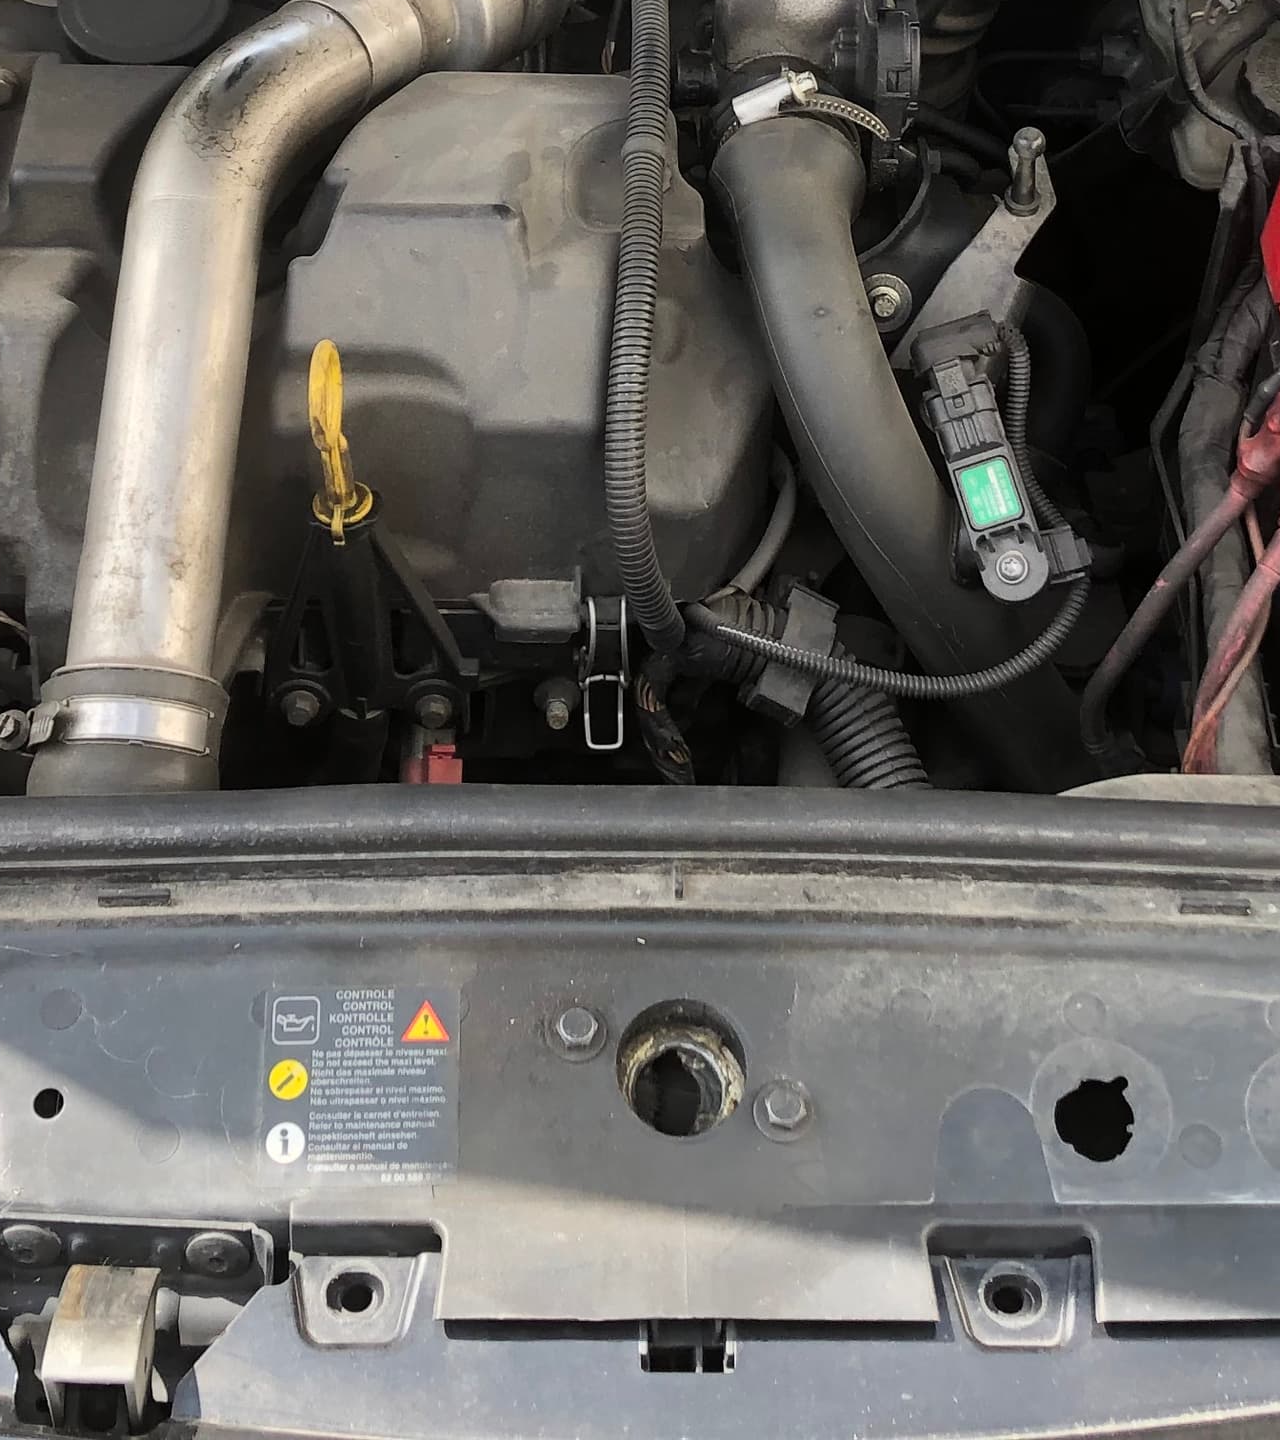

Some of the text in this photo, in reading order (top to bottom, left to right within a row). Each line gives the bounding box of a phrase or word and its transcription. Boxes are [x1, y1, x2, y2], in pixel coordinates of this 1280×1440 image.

[335, 989, 395, 1000] CONTROLE
[342, 1001, 395, 1012] CONTROL
[329, 1012, 394, 1024] KONTROLLE
[341, 1024, 394, 1036] CONTROL
[312, 1049, 324, 1058] Ne
[326, 1050, 342, 1060] pas
[312, 1059, 324, 1067] Do
[326, 1059, 340, 1068] not
[342, 1057, 373, 1067] exceed
[375, 1058, 390, 1067] the
[333, 1121, 344, 1130] to
